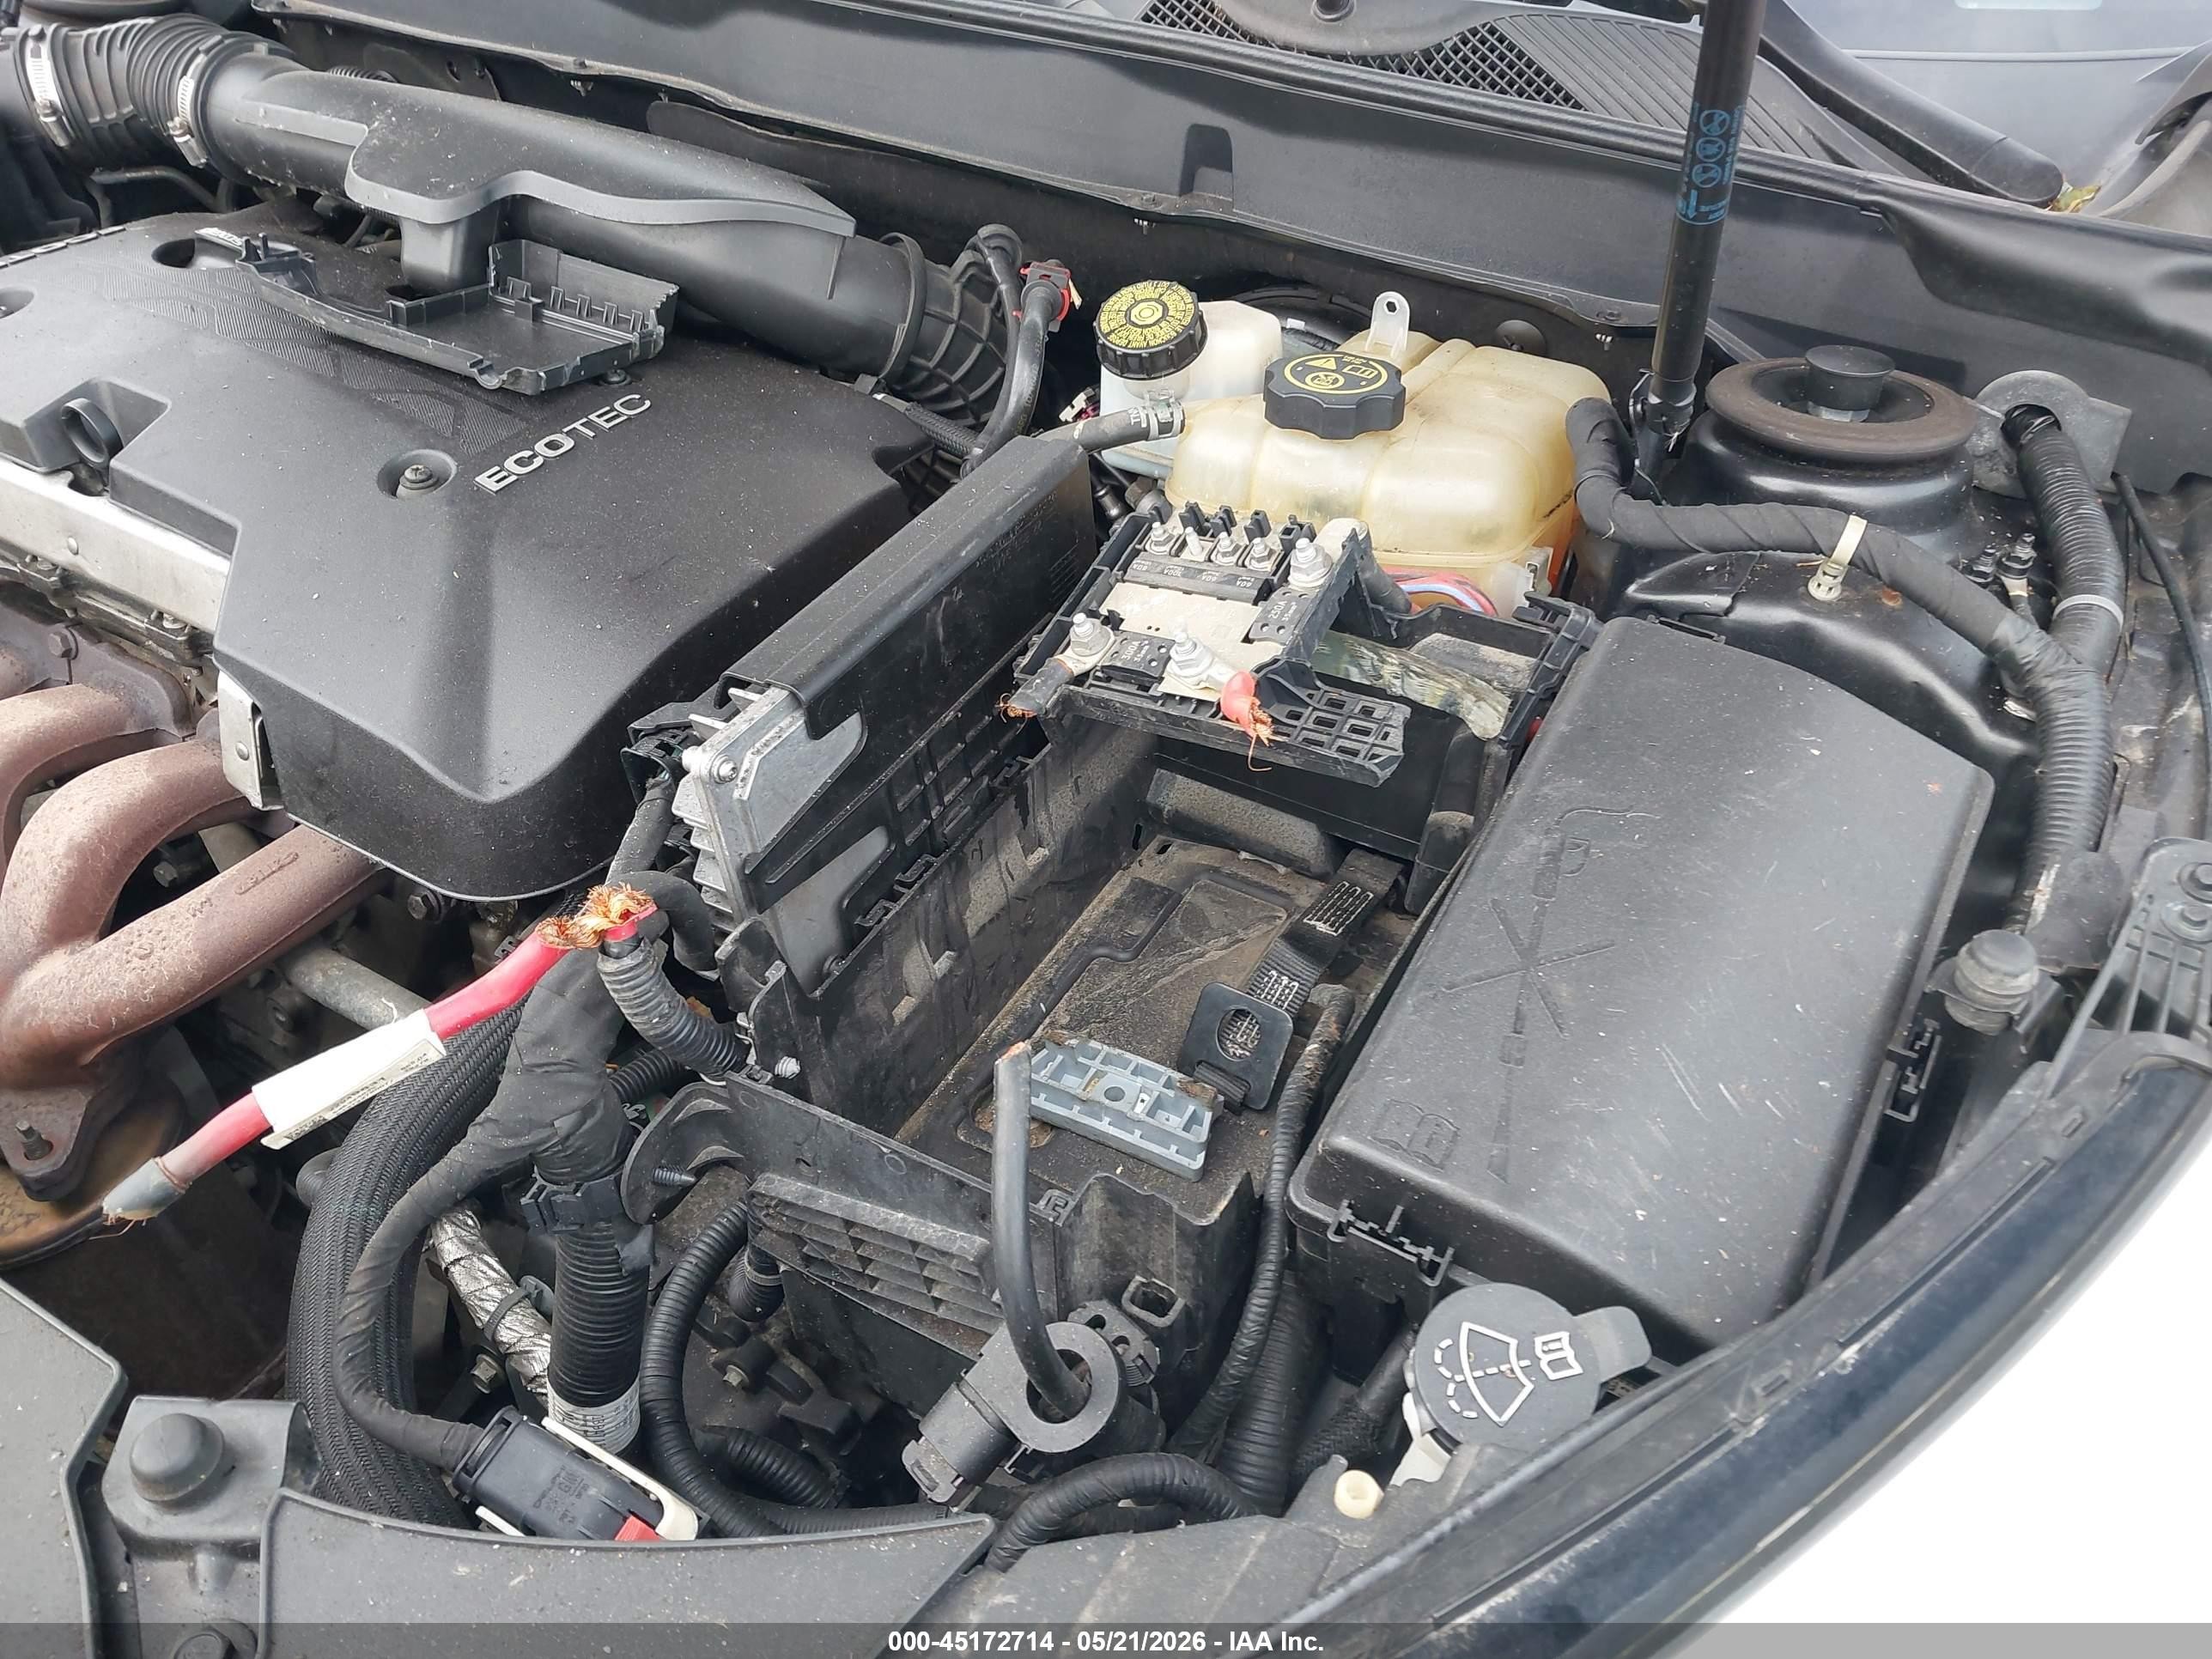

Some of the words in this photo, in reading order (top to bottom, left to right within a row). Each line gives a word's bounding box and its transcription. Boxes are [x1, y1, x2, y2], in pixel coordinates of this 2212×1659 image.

[474, 394, 651, 494] ECOTEC
[1268, 601, 1287, 619] 250A
[1121, 641, 1141, 660] 300A
